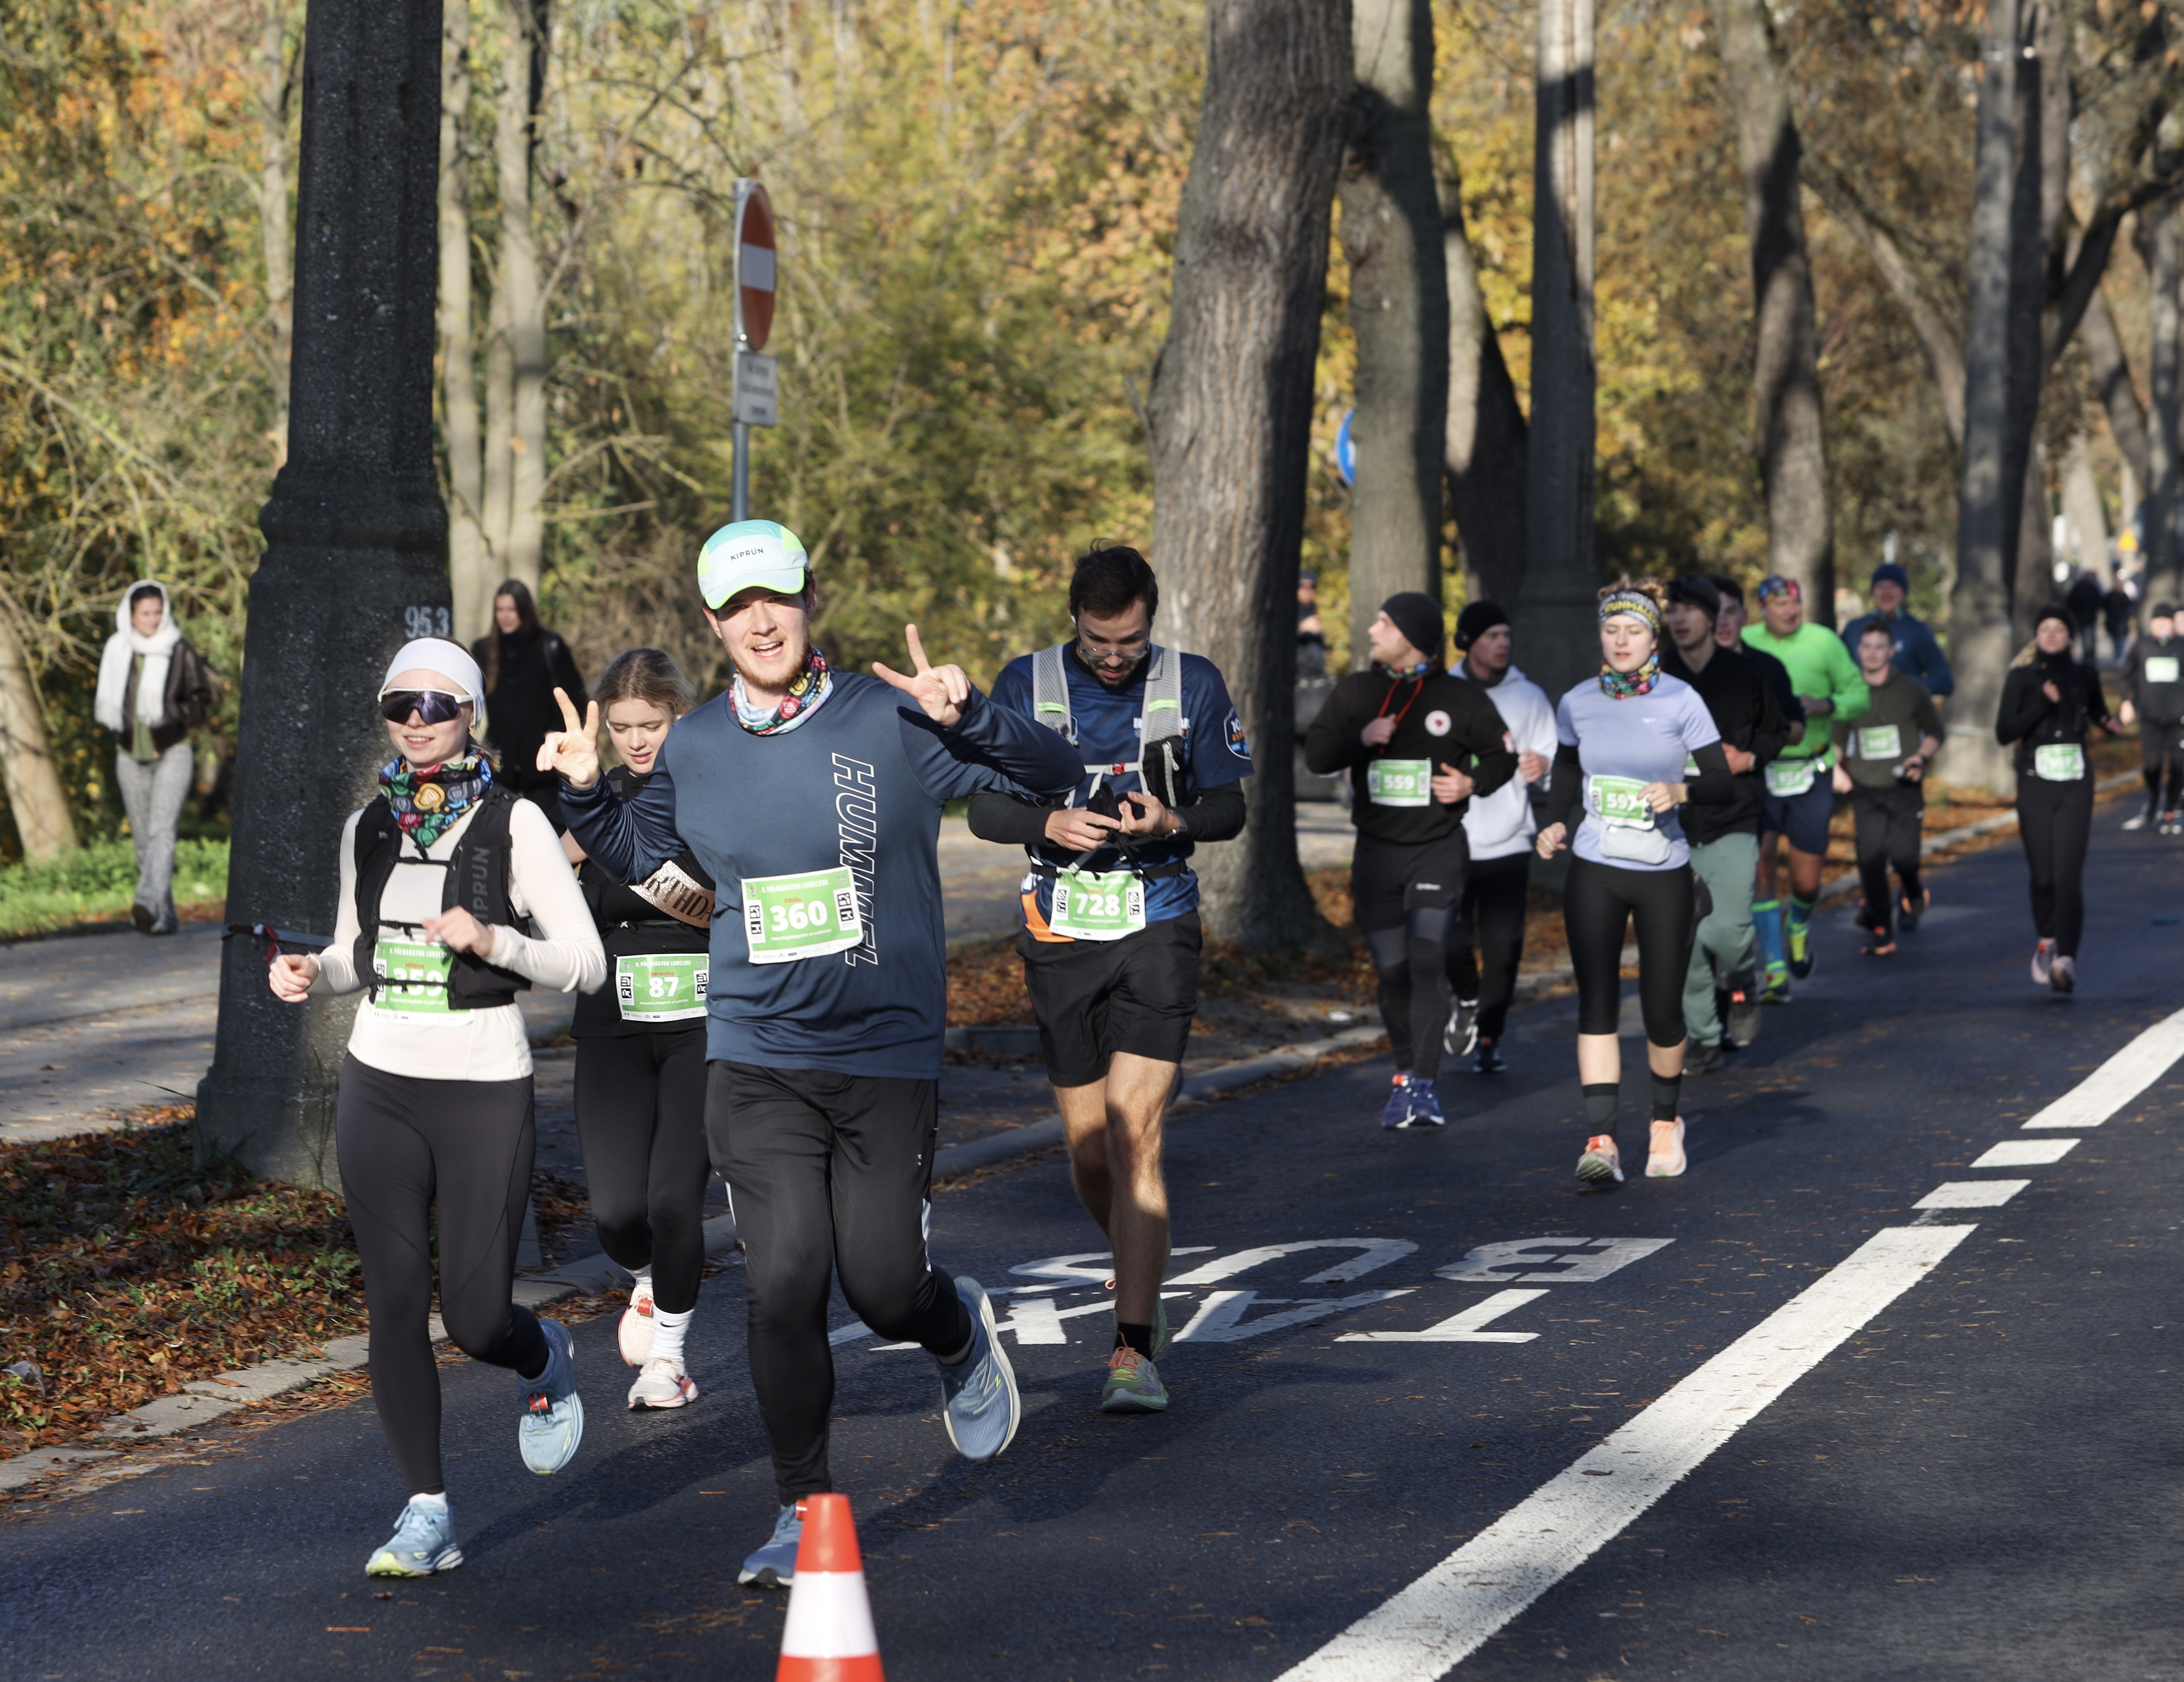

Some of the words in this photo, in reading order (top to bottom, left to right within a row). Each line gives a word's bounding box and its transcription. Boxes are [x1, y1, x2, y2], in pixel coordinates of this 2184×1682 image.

[731, 548, 763, 561] KIPRUN
[405, 605, 449, 639] 953
[1384, 774, 1415, 790] 559
[1606, 793, 1638, 812] 597
[472, 846, 490, 923] IPRUN
[770, 900, 828, 932] 360
[1075, 893, 1121, 916] 728
[392, 967, 444, 997] 359
[649, 977, 679, 998] 87
